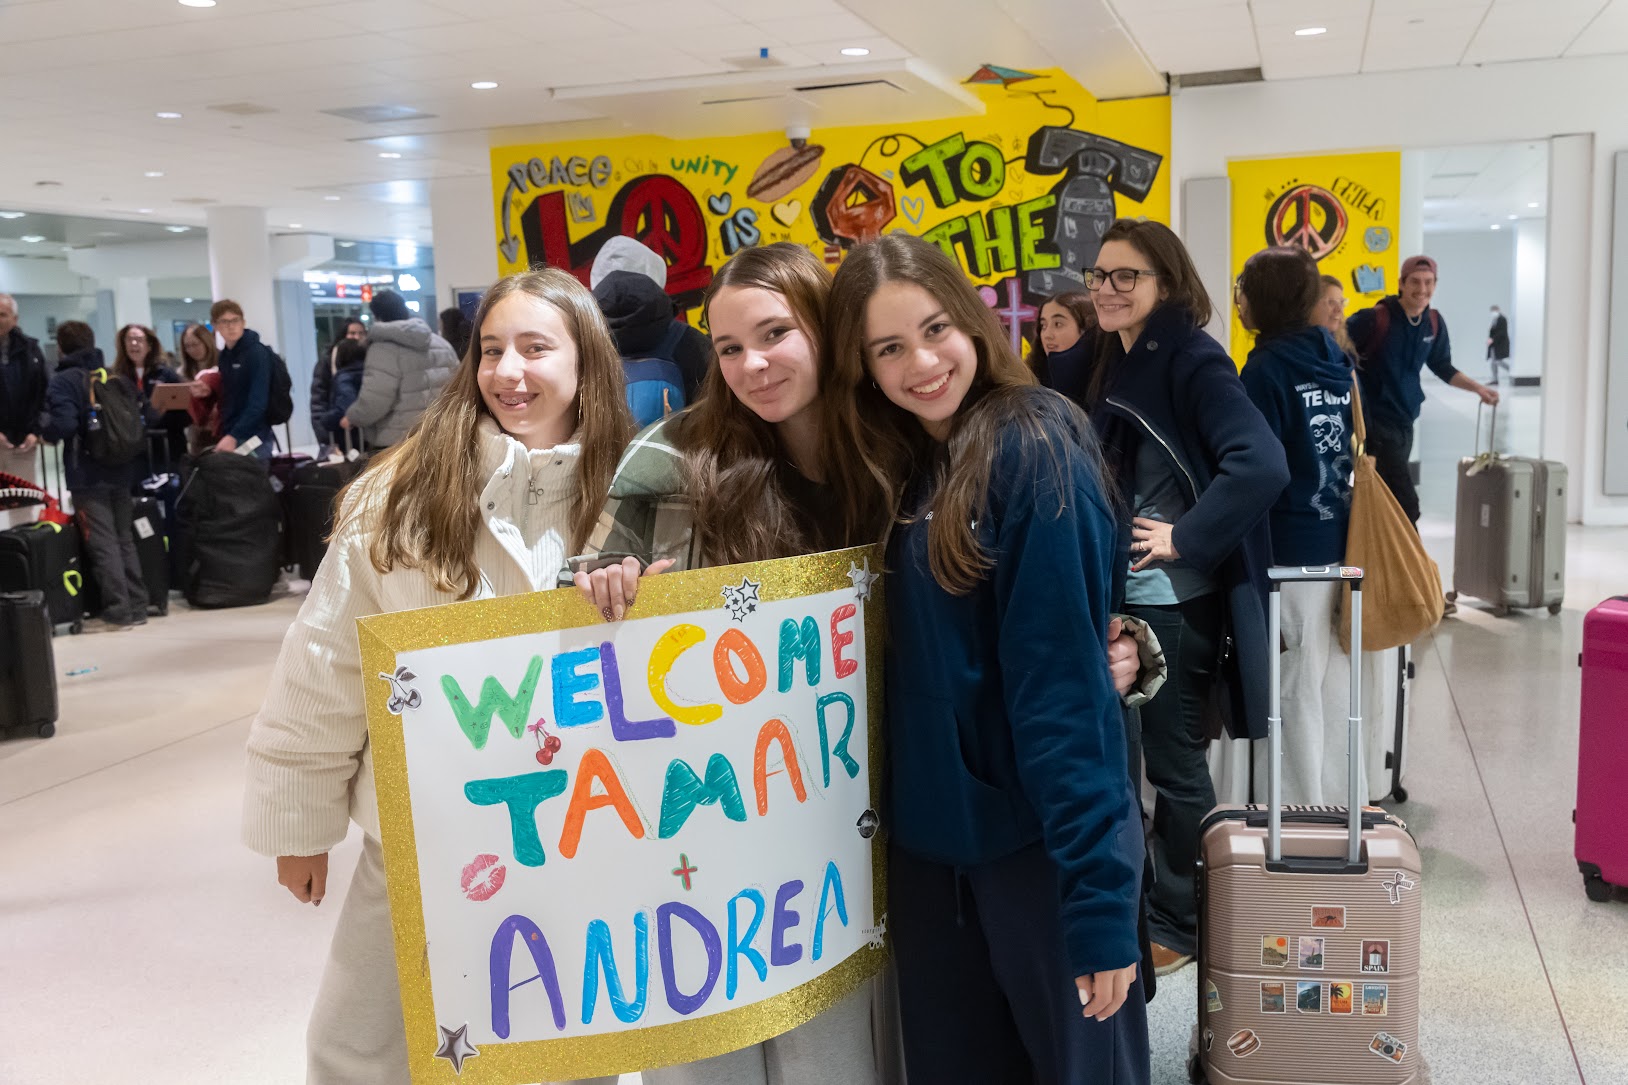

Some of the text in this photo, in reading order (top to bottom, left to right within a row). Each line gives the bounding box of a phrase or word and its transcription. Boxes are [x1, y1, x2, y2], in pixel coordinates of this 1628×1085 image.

[900, 131, 1005, 209] TO
[921, 194, 1061, 277] THE
[1302, 390, 1323, 407] TE
[440, 604, 858, 750] WELCOME
[463, 691, 860, 867] TAMAR
[490, 860, 849, 1039] ANDREA
